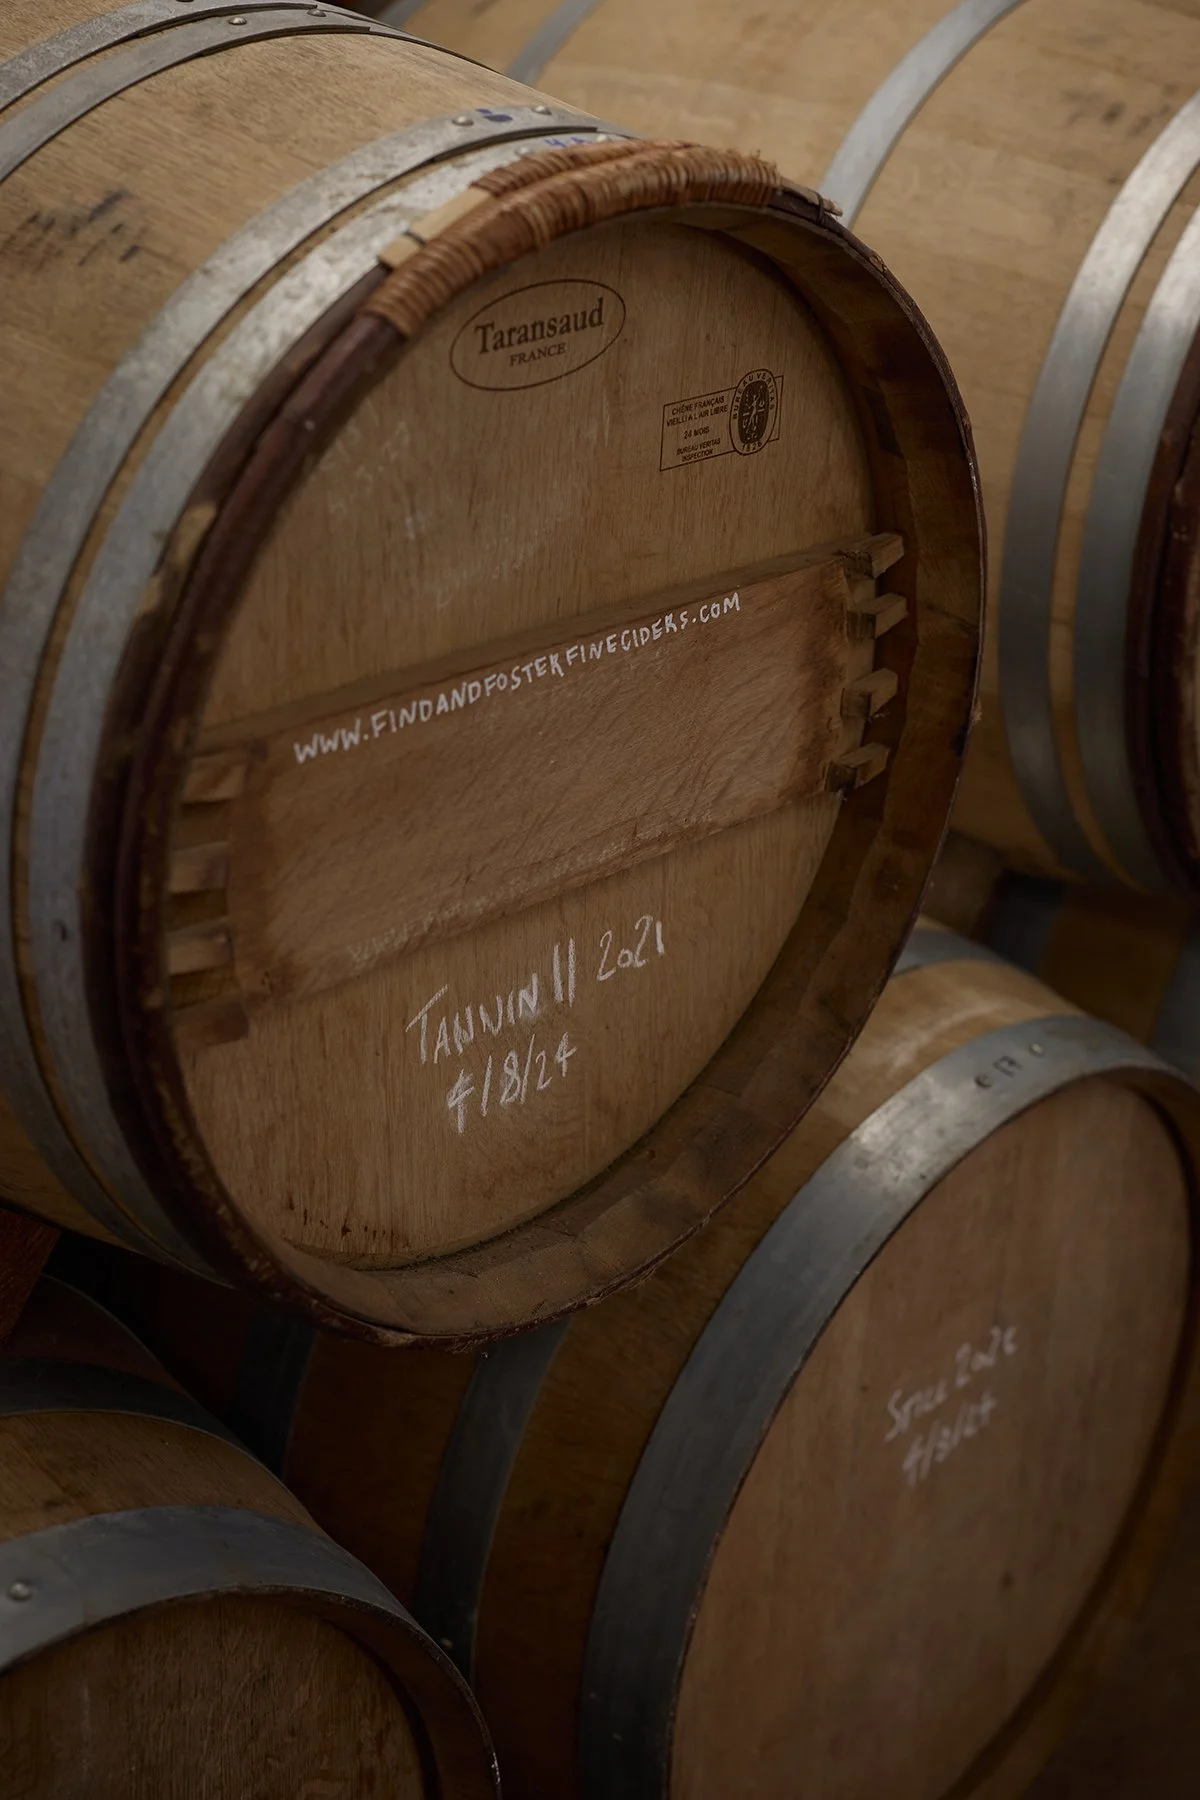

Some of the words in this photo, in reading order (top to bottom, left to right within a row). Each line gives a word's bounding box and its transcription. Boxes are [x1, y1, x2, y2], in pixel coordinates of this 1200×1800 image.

[474, 297, 604, 355] Taransaud
[509, 342, 566, 367] FRANCE
[694, 396, 725, 409] FRANÇAIS
[733, 374, 754, 420] BUREAU
[757, 372, 775, 410] VERITAS
[710, 404, 728, 416] LIBRE
[684, 429, 692, 440] 24
[693, 426, 710, 437] MOIS
[676, 444, 698, 456] BUREAU
[699, 438, 721, 449] VERITAS
[681, 449, 714, 462] INSPECTION
[405, 973, 539, 1065] TANNIN
[597, 914, 665, 982] 2021
[447, 1031, 578, 1136] 4/8/24
